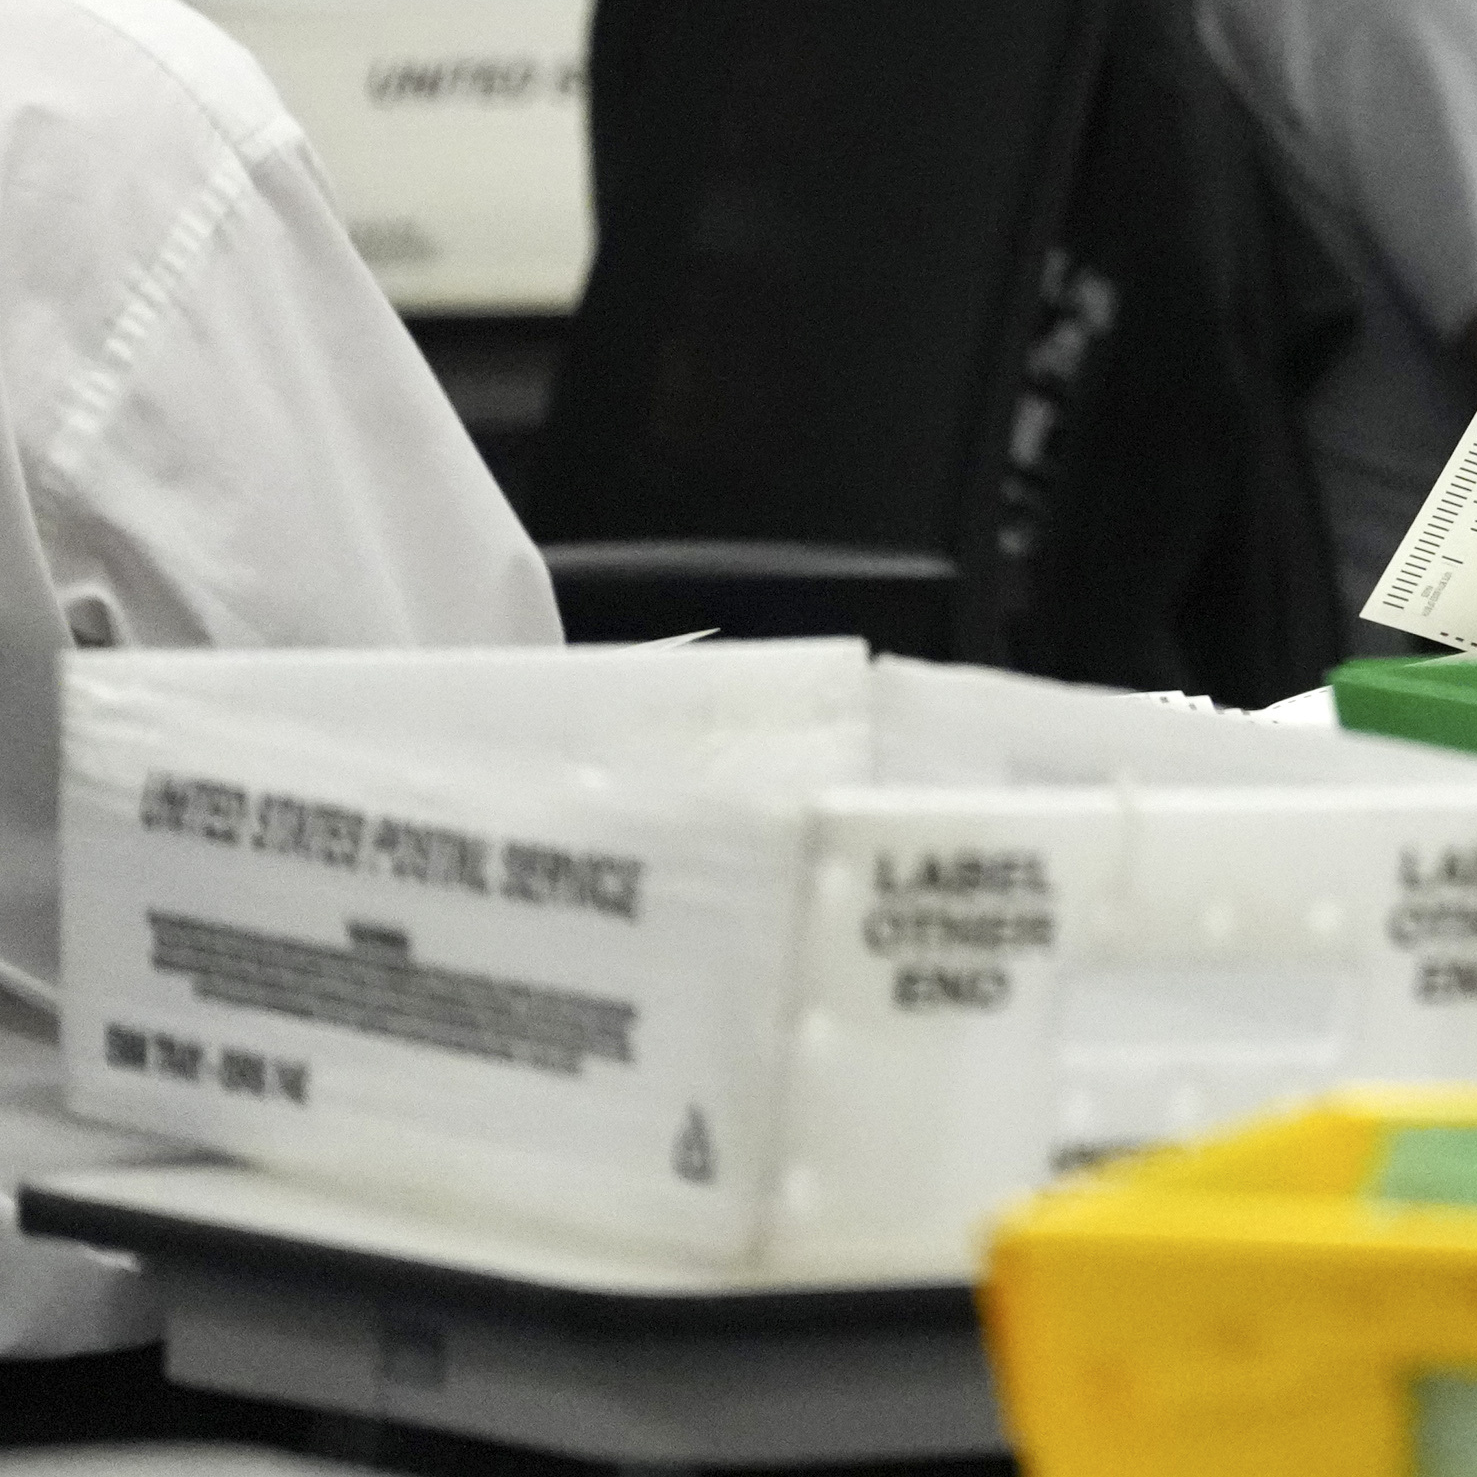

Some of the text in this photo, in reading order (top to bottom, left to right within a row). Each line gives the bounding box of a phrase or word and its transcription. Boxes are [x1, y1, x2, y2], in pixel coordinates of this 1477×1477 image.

[139, 772, 645, 924] UNITED STATES POSTAL SERVICE
[872, 848, 1050, 897] LABEL
[861, 907, 1056, 956] OTHER
[891, 965, 1012, 1013] END
